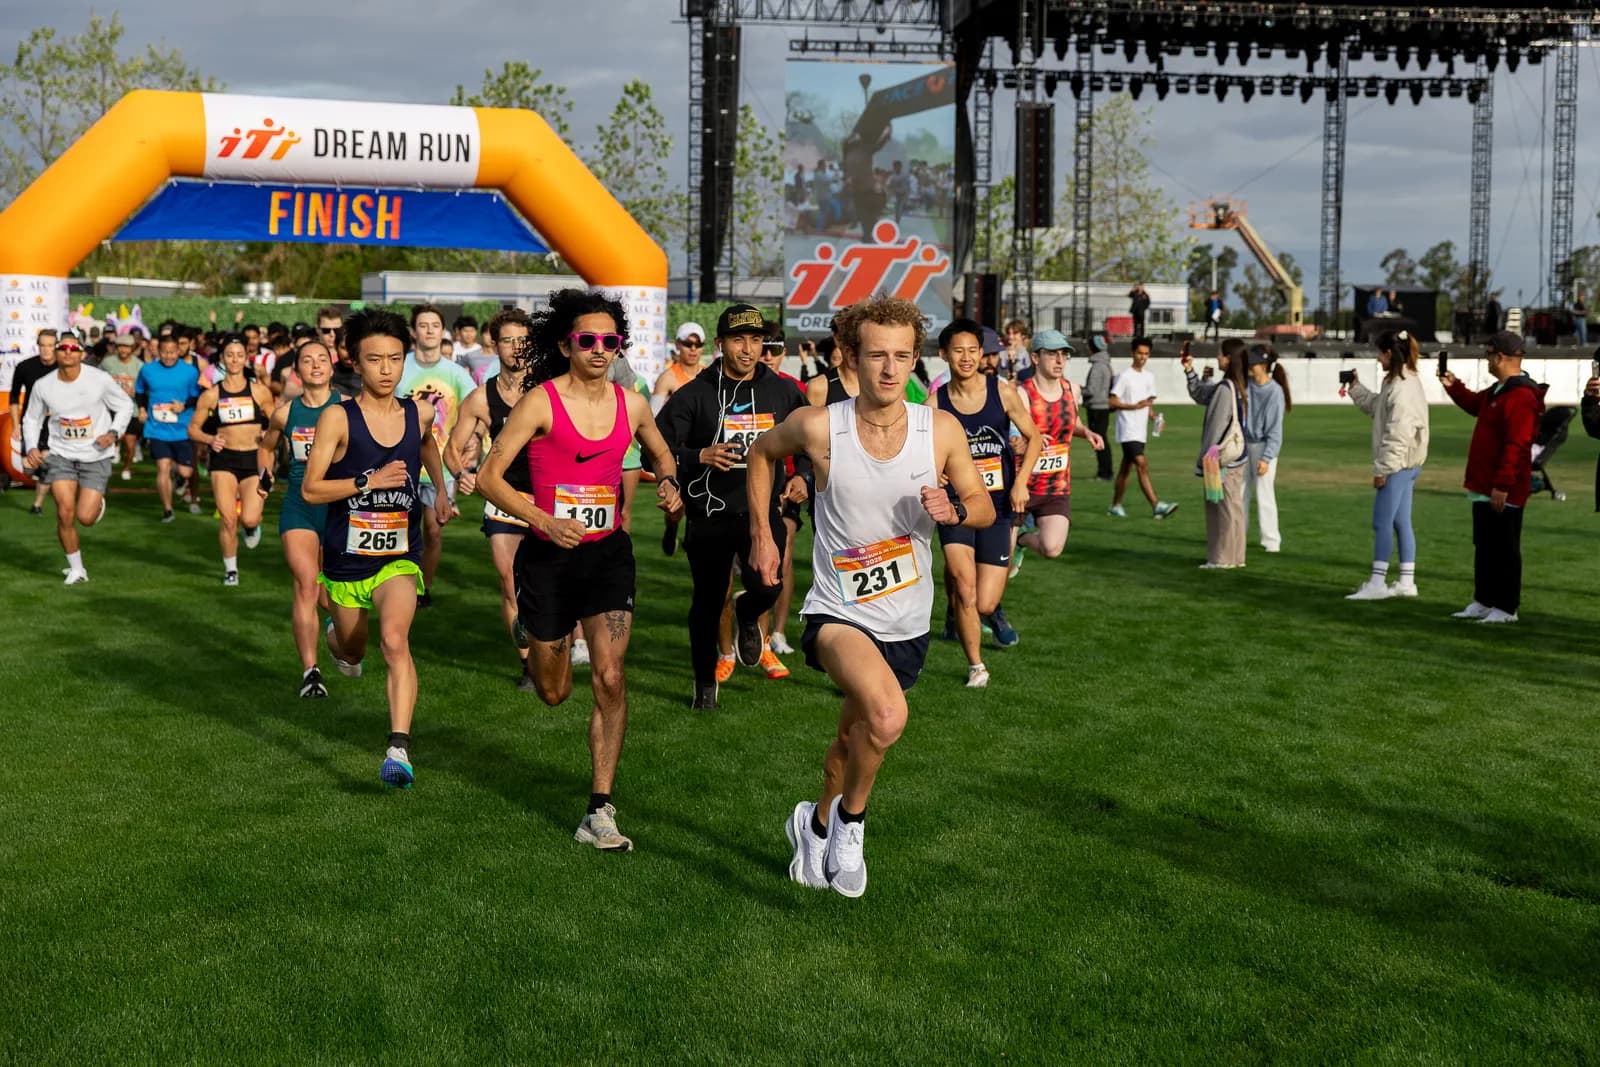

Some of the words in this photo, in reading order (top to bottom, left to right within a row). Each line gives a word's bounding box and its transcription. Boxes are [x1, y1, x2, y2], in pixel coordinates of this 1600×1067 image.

[314, 128, 407, 161] DREAM
[419, 132, 470, 163] RUN
[268, 190, 402, 240] FINISH
[229, 408, 242, 420] 51
[65, 427, 88, 438] 412
[969, 442, 1003, 455] RVINE
[1040, 456, 1062, 470] 275
[348, 495, 370, 509] UC
[372, 491, 414, 509] IRVINE
[567, 507, 607, 528] 130
[358, 531, 397, 550] 265
[865, 555, 883, 566] 2025
[852, 560, 902, 597] 231
